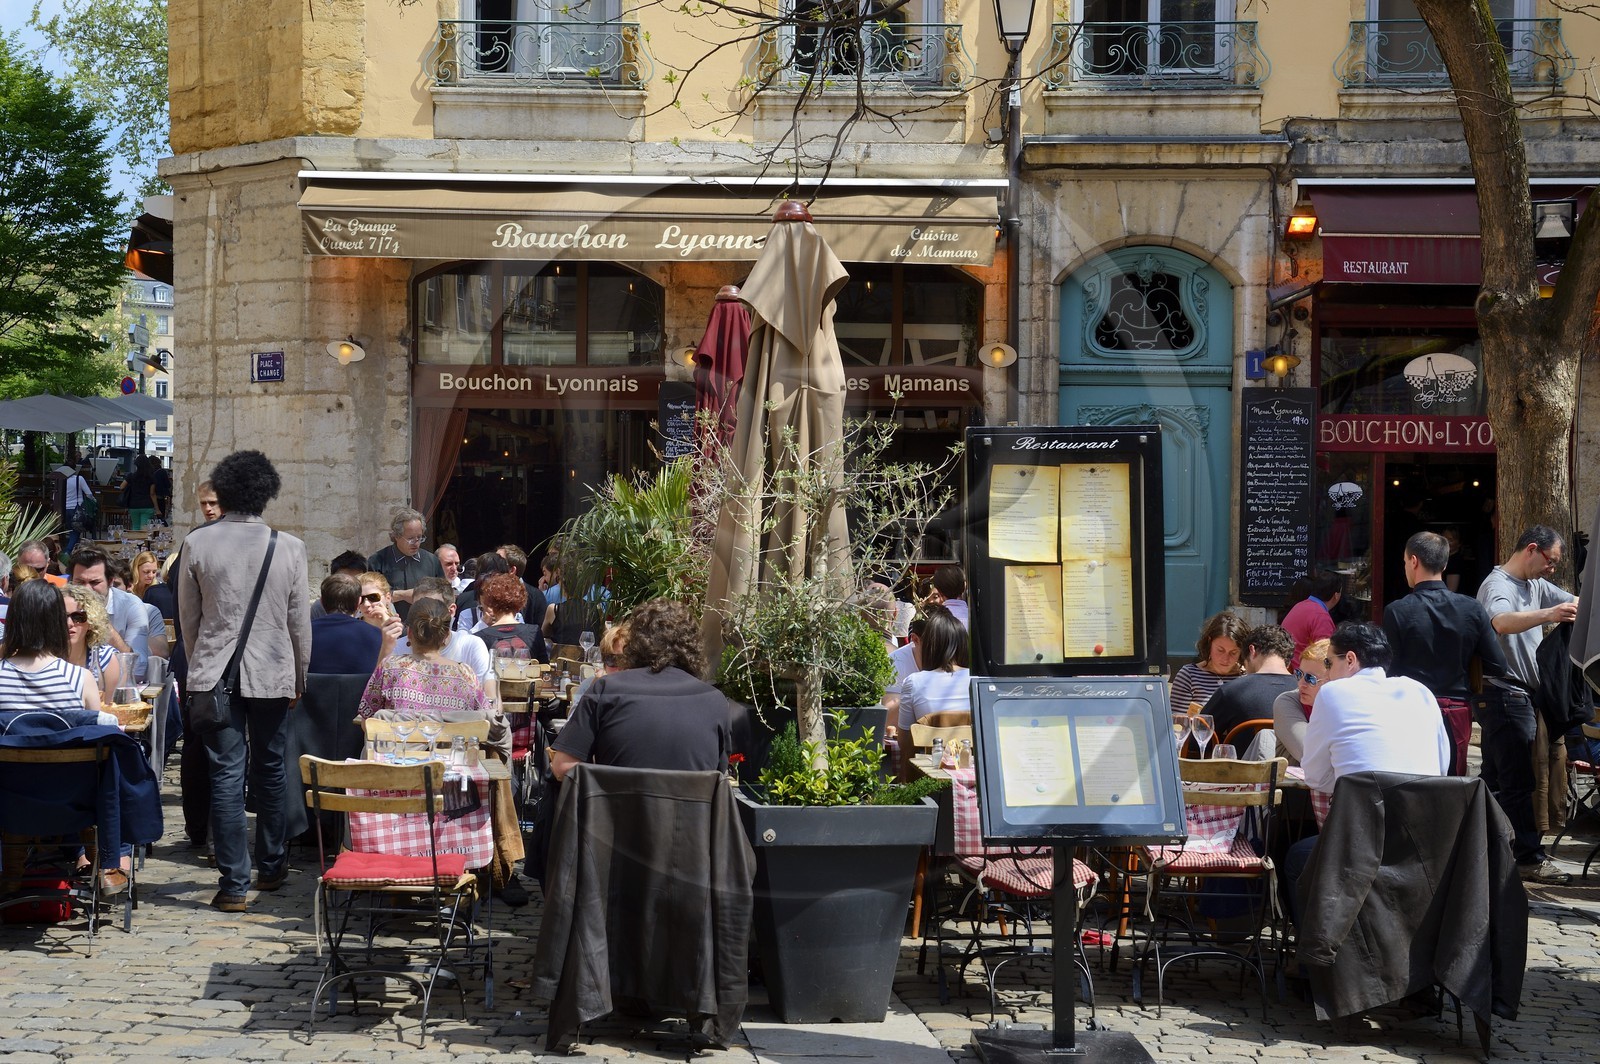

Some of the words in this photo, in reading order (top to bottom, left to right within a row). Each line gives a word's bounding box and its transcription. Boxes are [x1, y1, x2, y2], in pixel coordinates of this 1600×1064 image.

[322, 218, 342, 232] La
[347, 218, 397, 236] Grange
[491, 222, 629, 250] Bouchon
[910, 228, 960, 242] Cuisine
[320, 236, 364, 250] Ouvert
[890, 244, 912, 257] des
[916, 245, 979, 258] Mamans
[1343, 260, 1409, 275] RESTAURANT
[1252, 357, 1260, 373] 1
[439, 372, 532, 391] Bouchon
[545, 374, 639, 396] Lyonnais
[884, 374, 970, 392] Mamans
[1011, 436, 1120, 450] Restaurant
